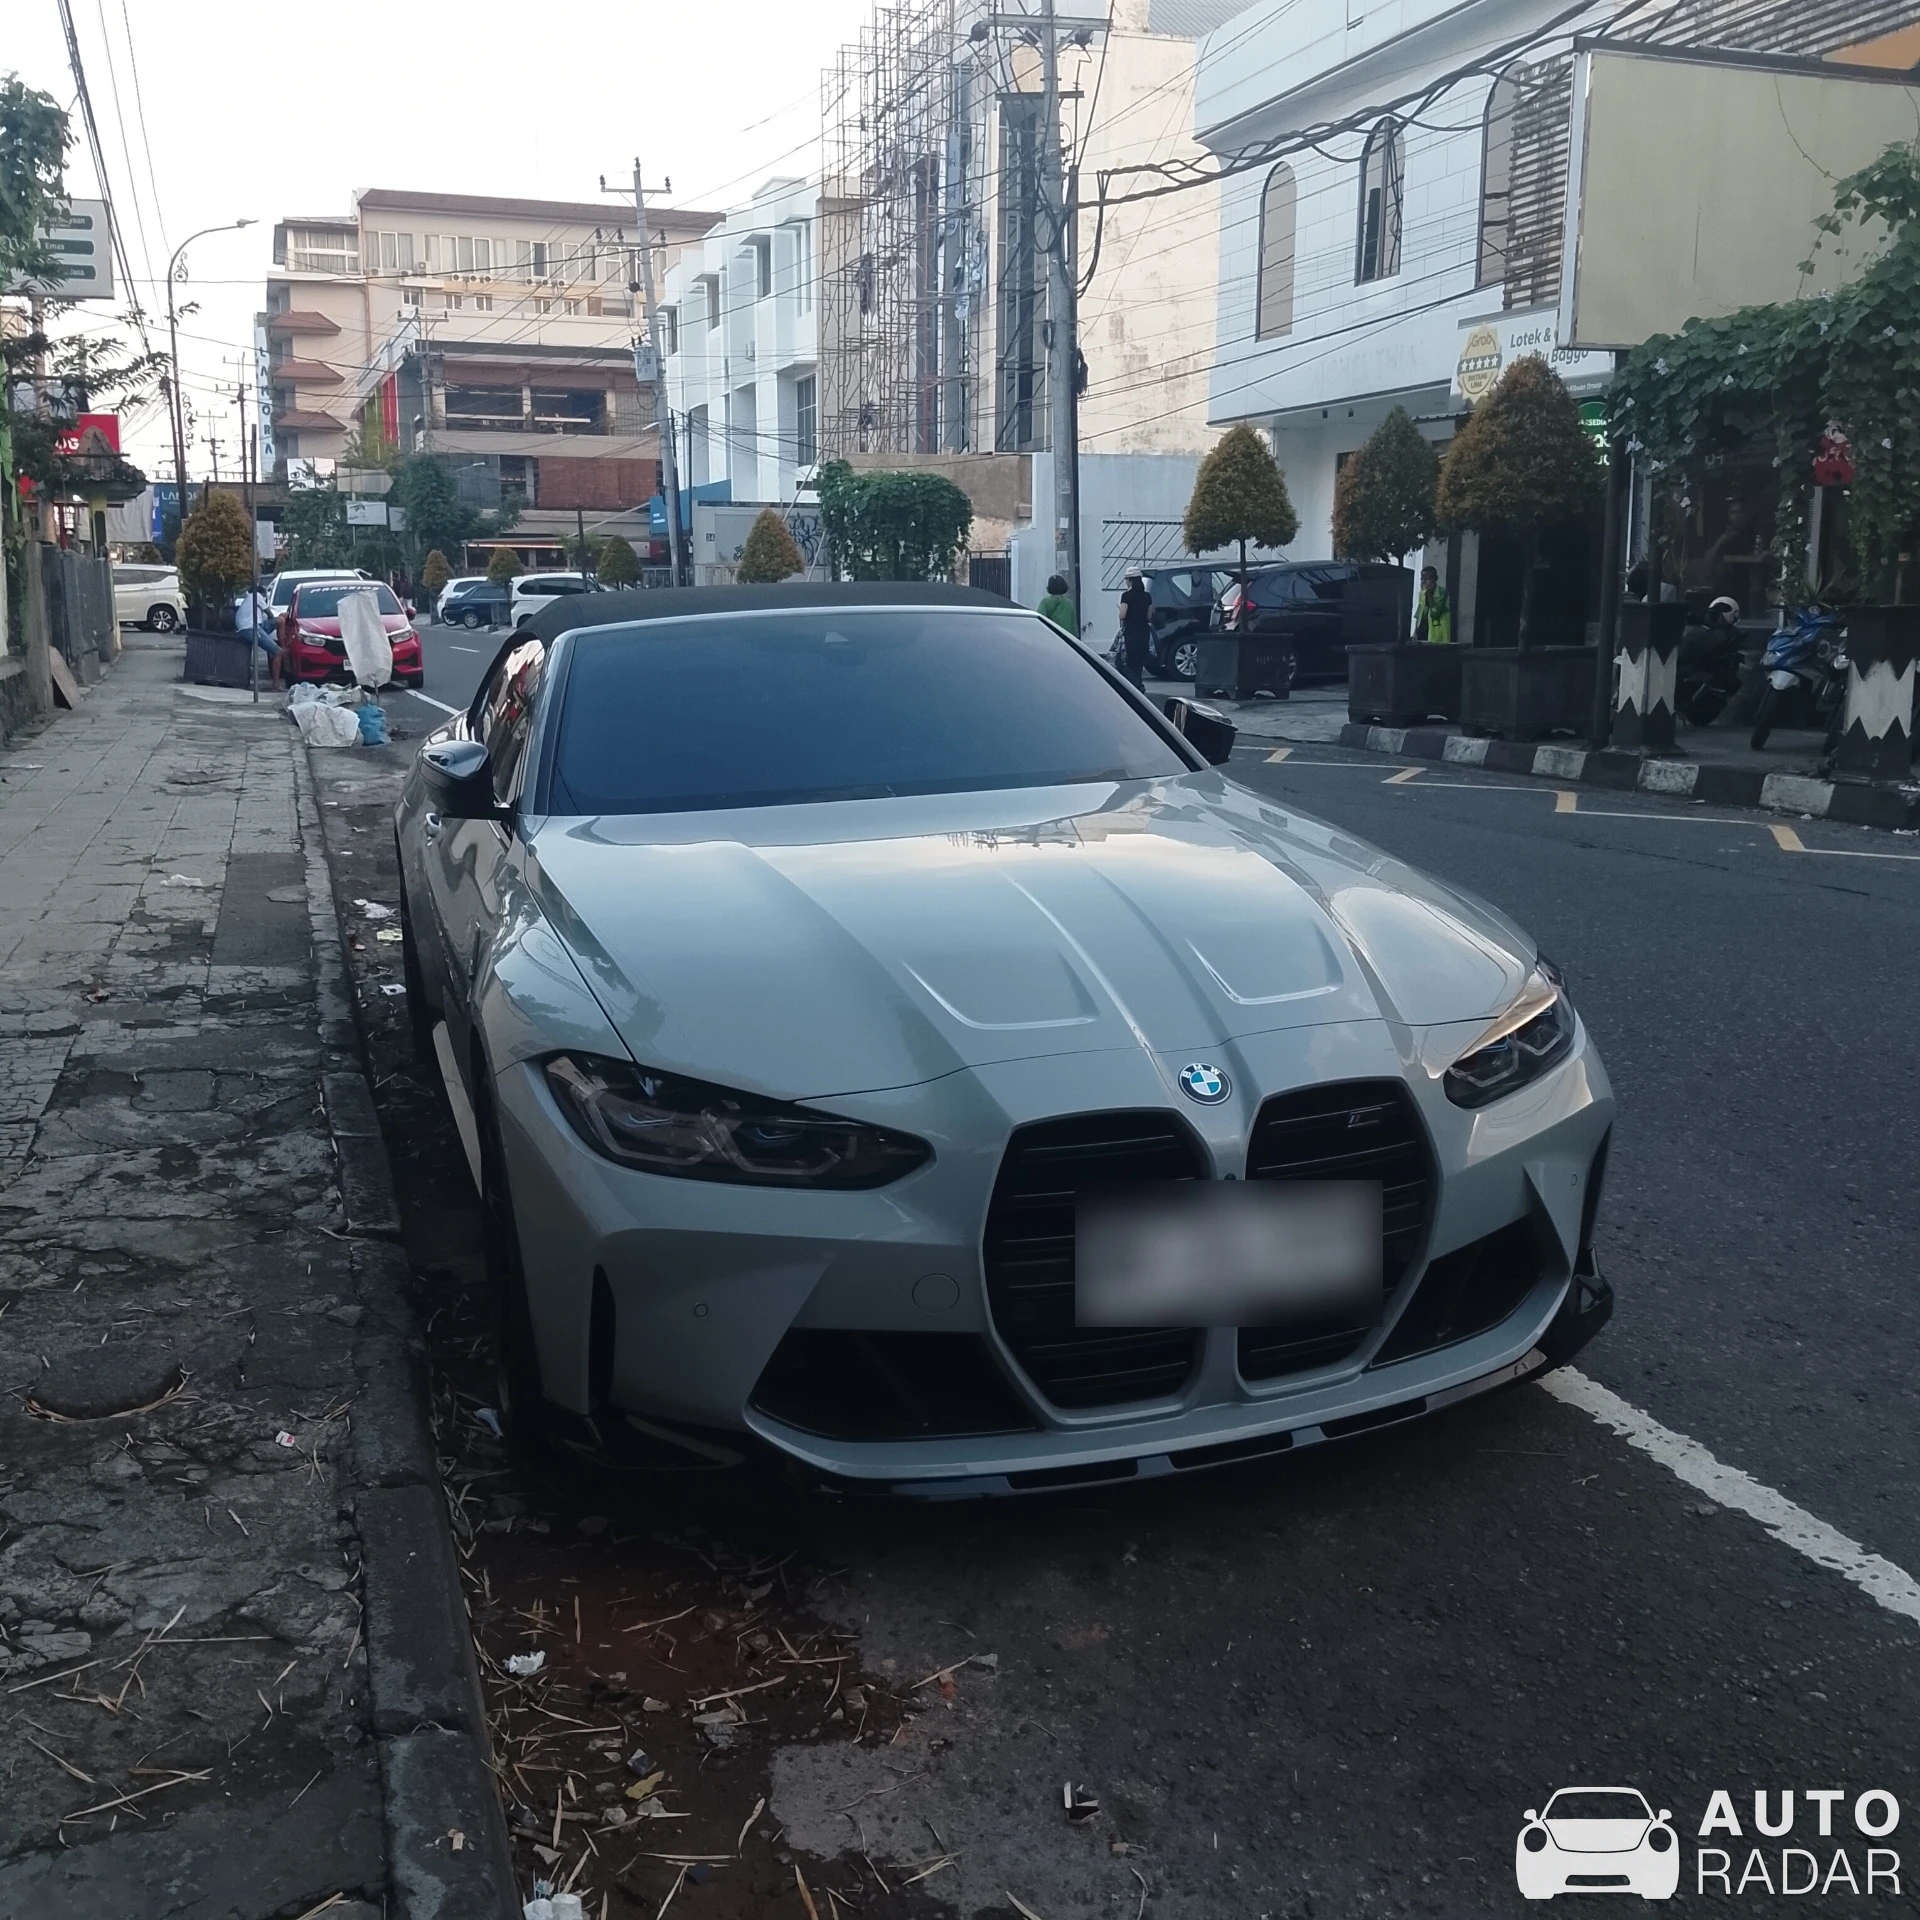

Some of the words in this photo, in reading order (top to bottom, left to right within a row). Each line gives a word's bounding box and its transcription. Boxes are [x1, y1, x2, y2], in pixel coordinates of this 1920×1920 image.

[43, 216, 85, 227] Pemyaan
[1471, 331, 1492, 347] Grab
[1510, 328, 1541, 348] Lotek
[1543, 327, 1551, 342] &
[1182, 1063, 1220, 1078] BMW
